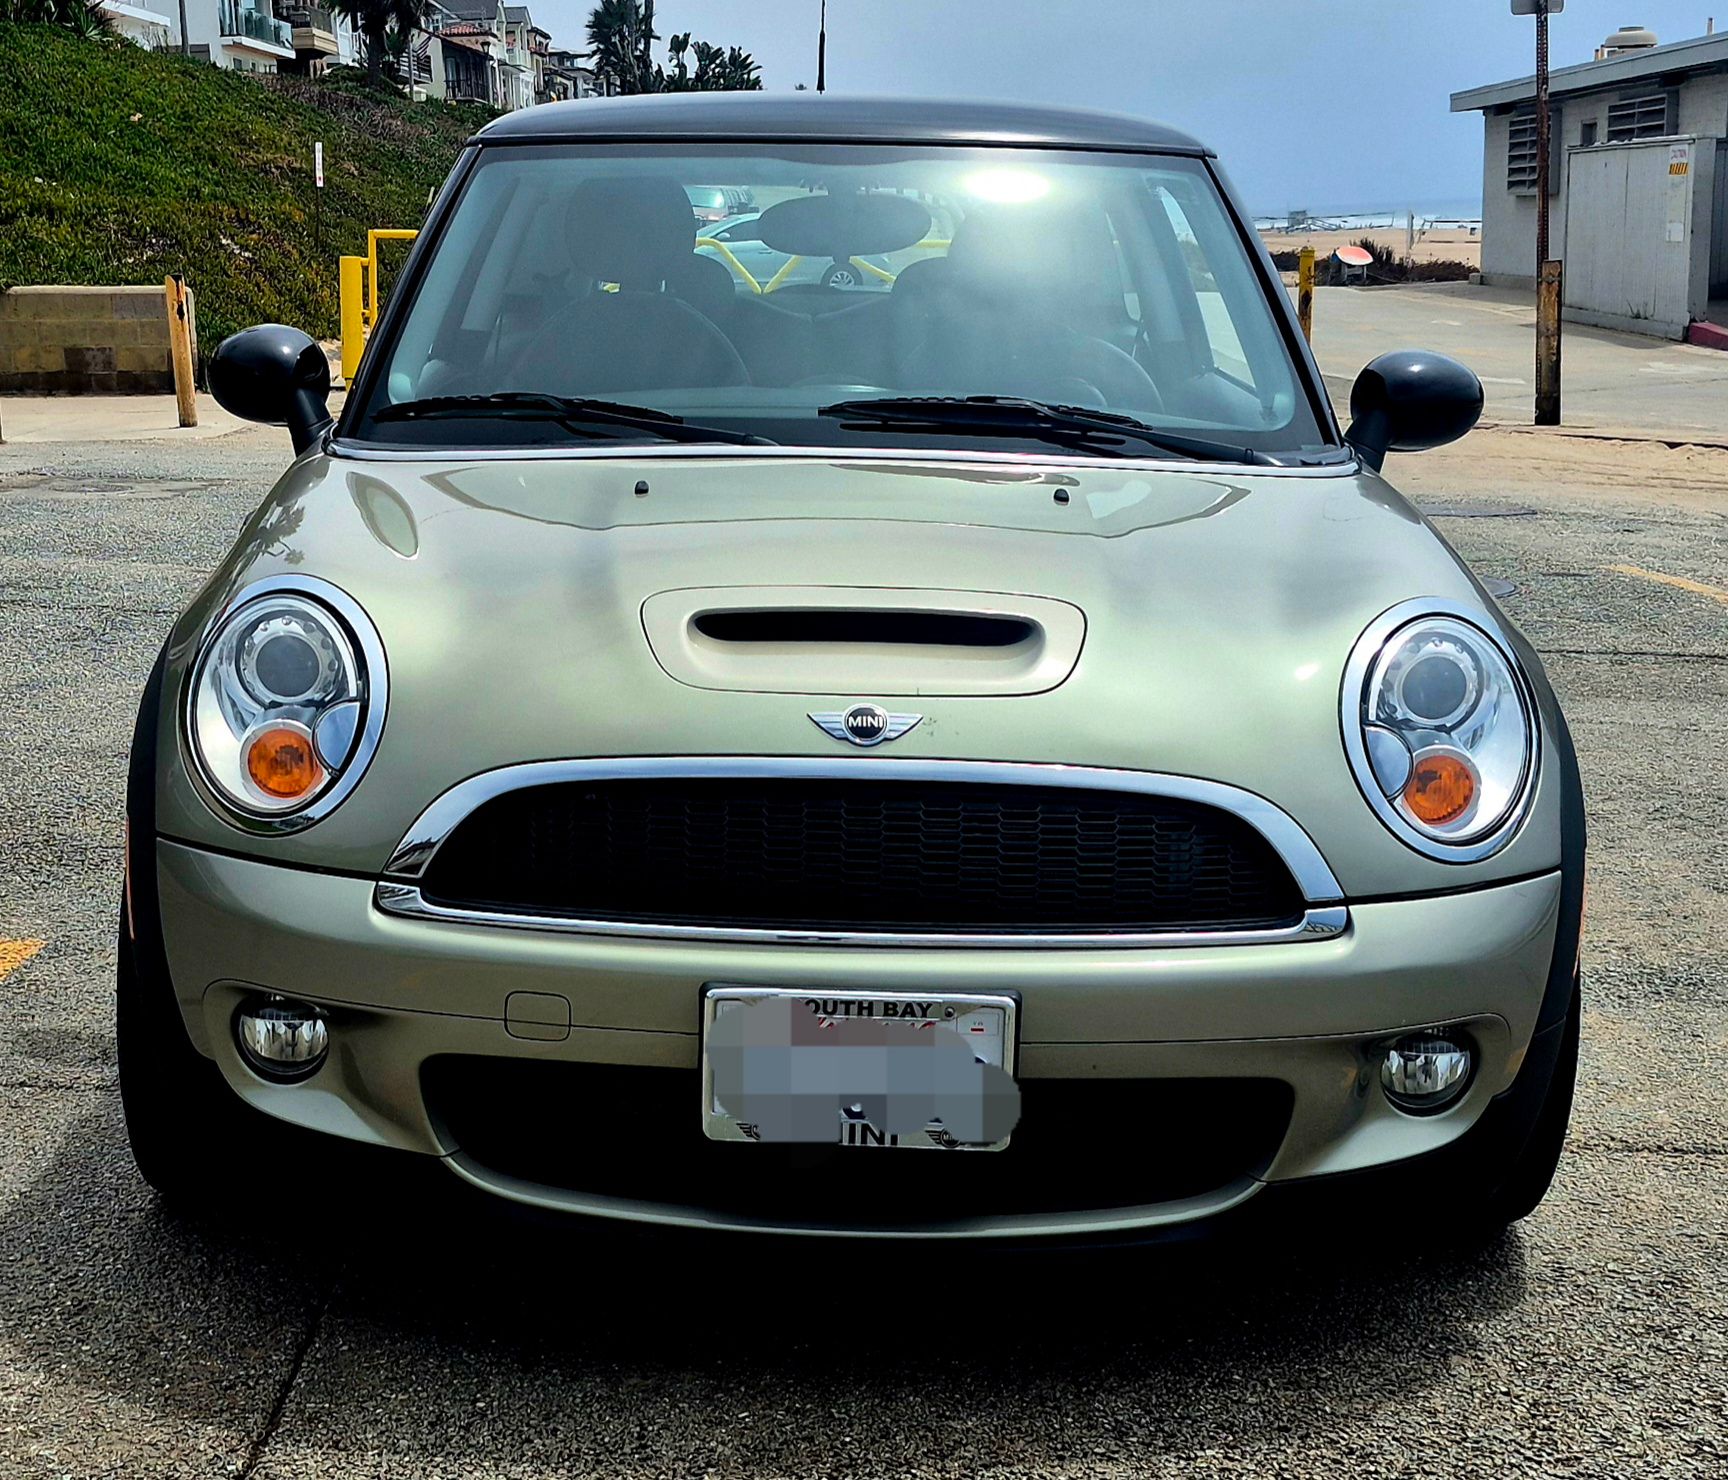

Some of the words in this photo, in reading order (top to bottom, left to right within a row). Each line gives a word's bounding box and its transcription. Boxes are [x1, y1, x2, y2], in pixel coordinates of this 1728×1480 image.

[848, 715, 883, 728] MINI
[805, 999, 874, 1017] OUTH
[883, 1001, 933, 1018] BAY
